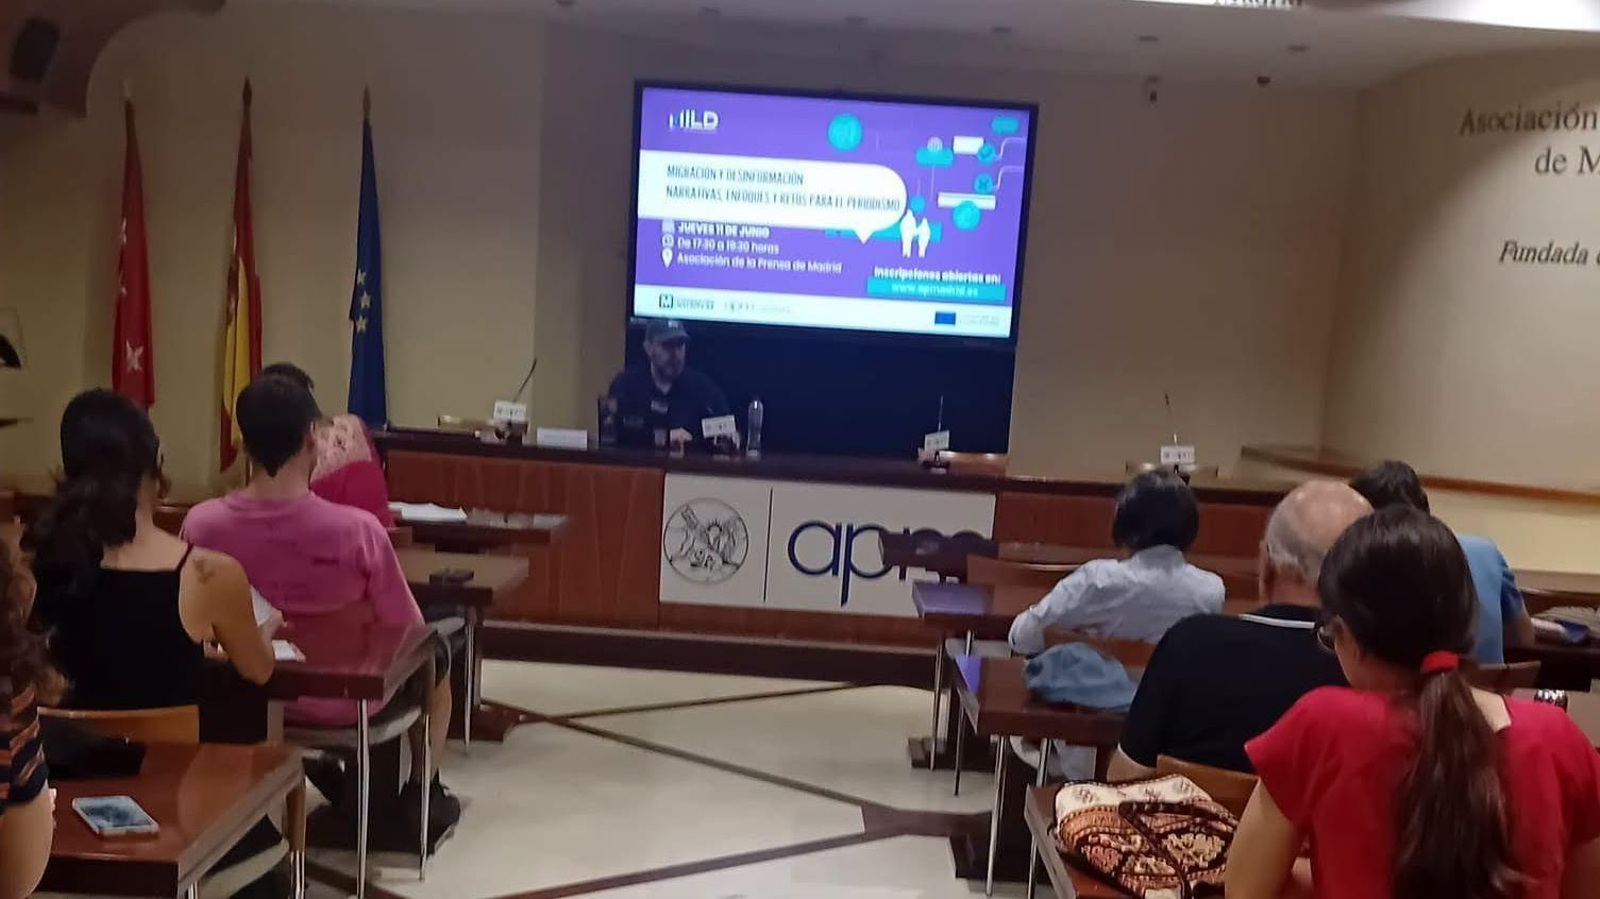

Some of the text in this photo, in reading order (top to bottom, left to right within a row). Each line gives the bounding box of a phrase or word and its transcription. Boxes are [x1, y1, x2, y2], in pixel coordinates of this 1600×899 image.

[1459, 102, 1598, 136] Asociación
[1534, 145, 1567, 174] de
[809, 194, 833, 208] PARA
[847, 195, 900, 211] PERIODISMO
[725, 224, 738, 237] DE
[739, 225, 770, 238] JUNIO
[677, 237, 691, 249] De
[717, 241, 725, 251] a
[751, 242, 780, 255] horas
[1499, 239, 1588, 265] Fundada
[731, 256, 745, 269] de
[757, 258, 791, 271] Prensa
[792, 260, 806, 272] de
[807, 261, 842, 274] Madrid
